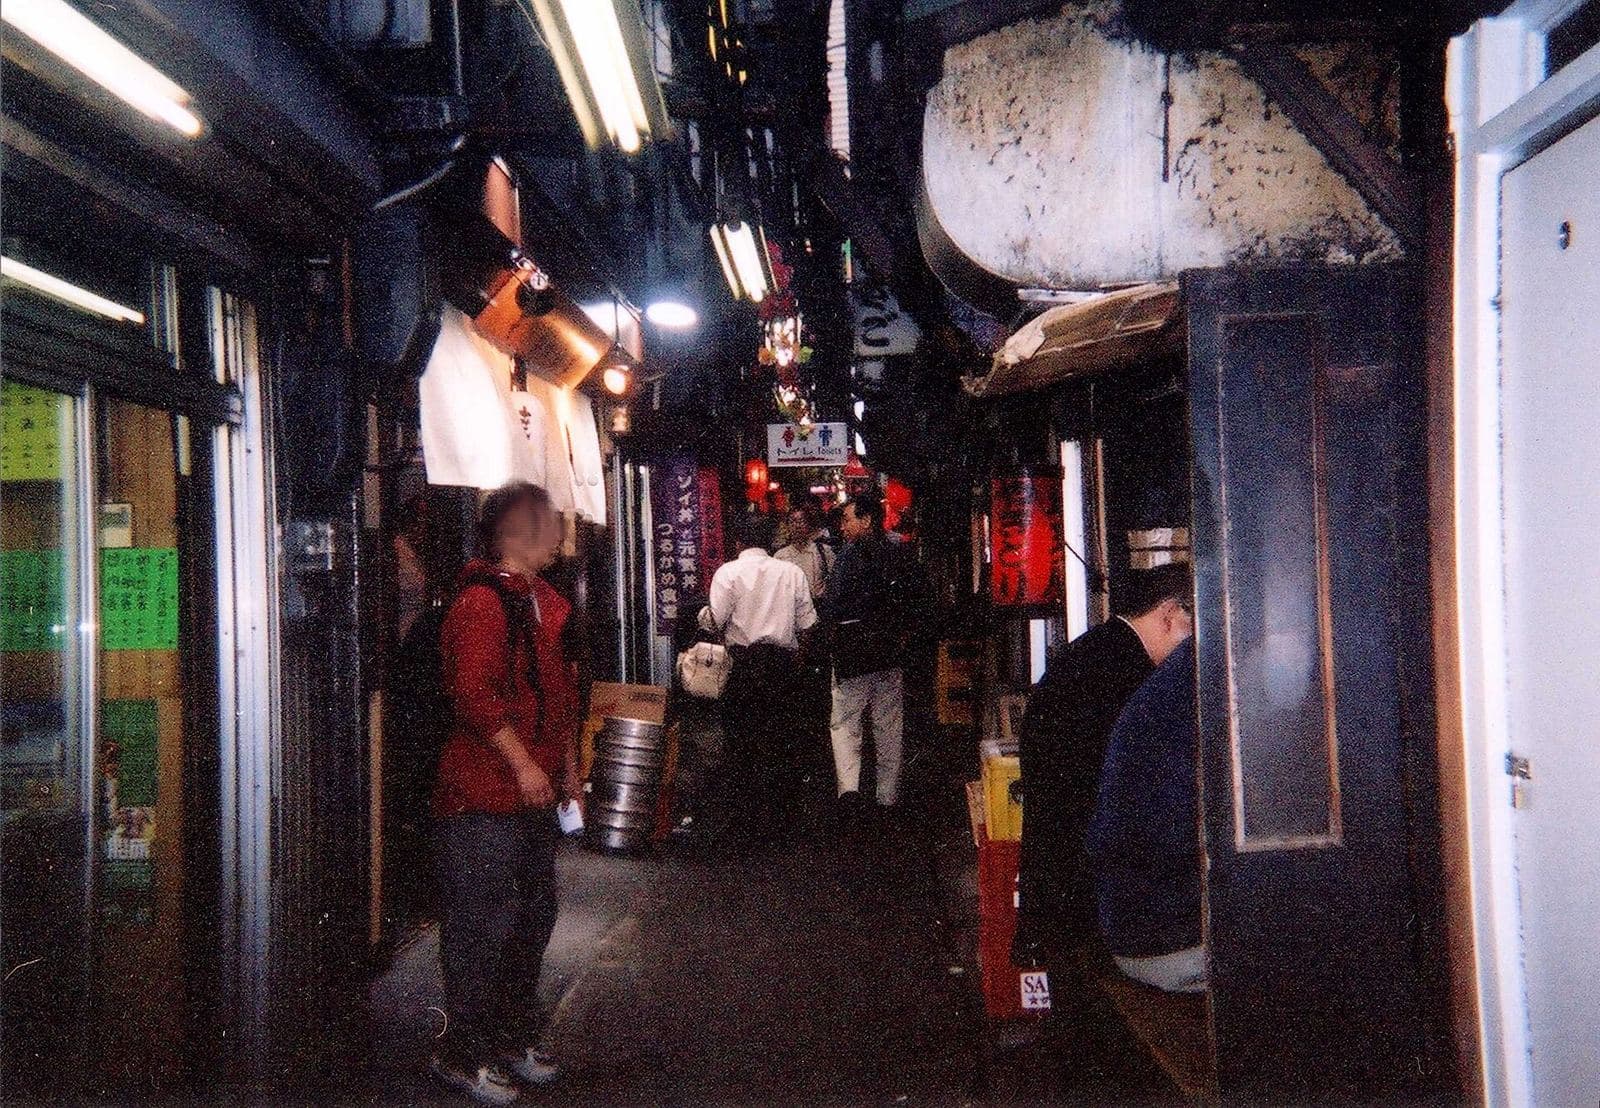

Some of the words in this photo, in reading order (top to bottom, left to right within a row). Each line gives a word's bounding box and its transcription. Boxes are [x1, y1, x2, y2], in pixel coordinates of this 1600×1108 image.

[777, 447, 814, 456] トイレ
[1024, 975, 1048, 993] SA
